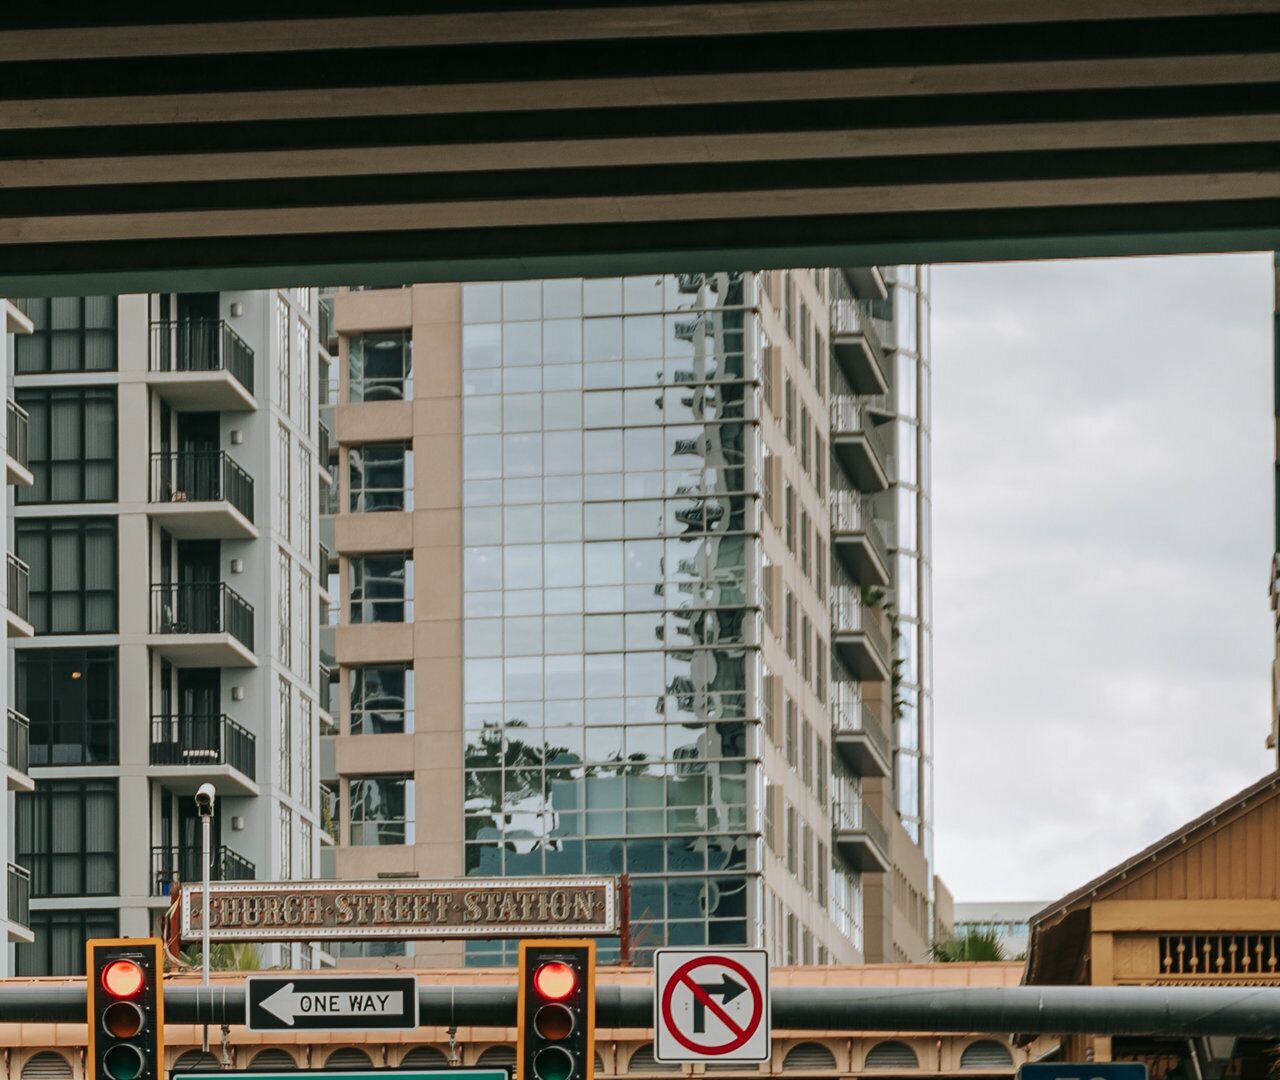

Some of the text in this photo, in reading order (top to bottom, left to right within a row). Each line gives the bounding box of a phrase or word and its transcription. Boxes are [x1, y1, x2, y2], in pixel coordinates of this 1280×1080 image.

[206, 889, 597, 927] CHURCH STREET STATION
[300, 994, 390, 1012] ONE WAY
